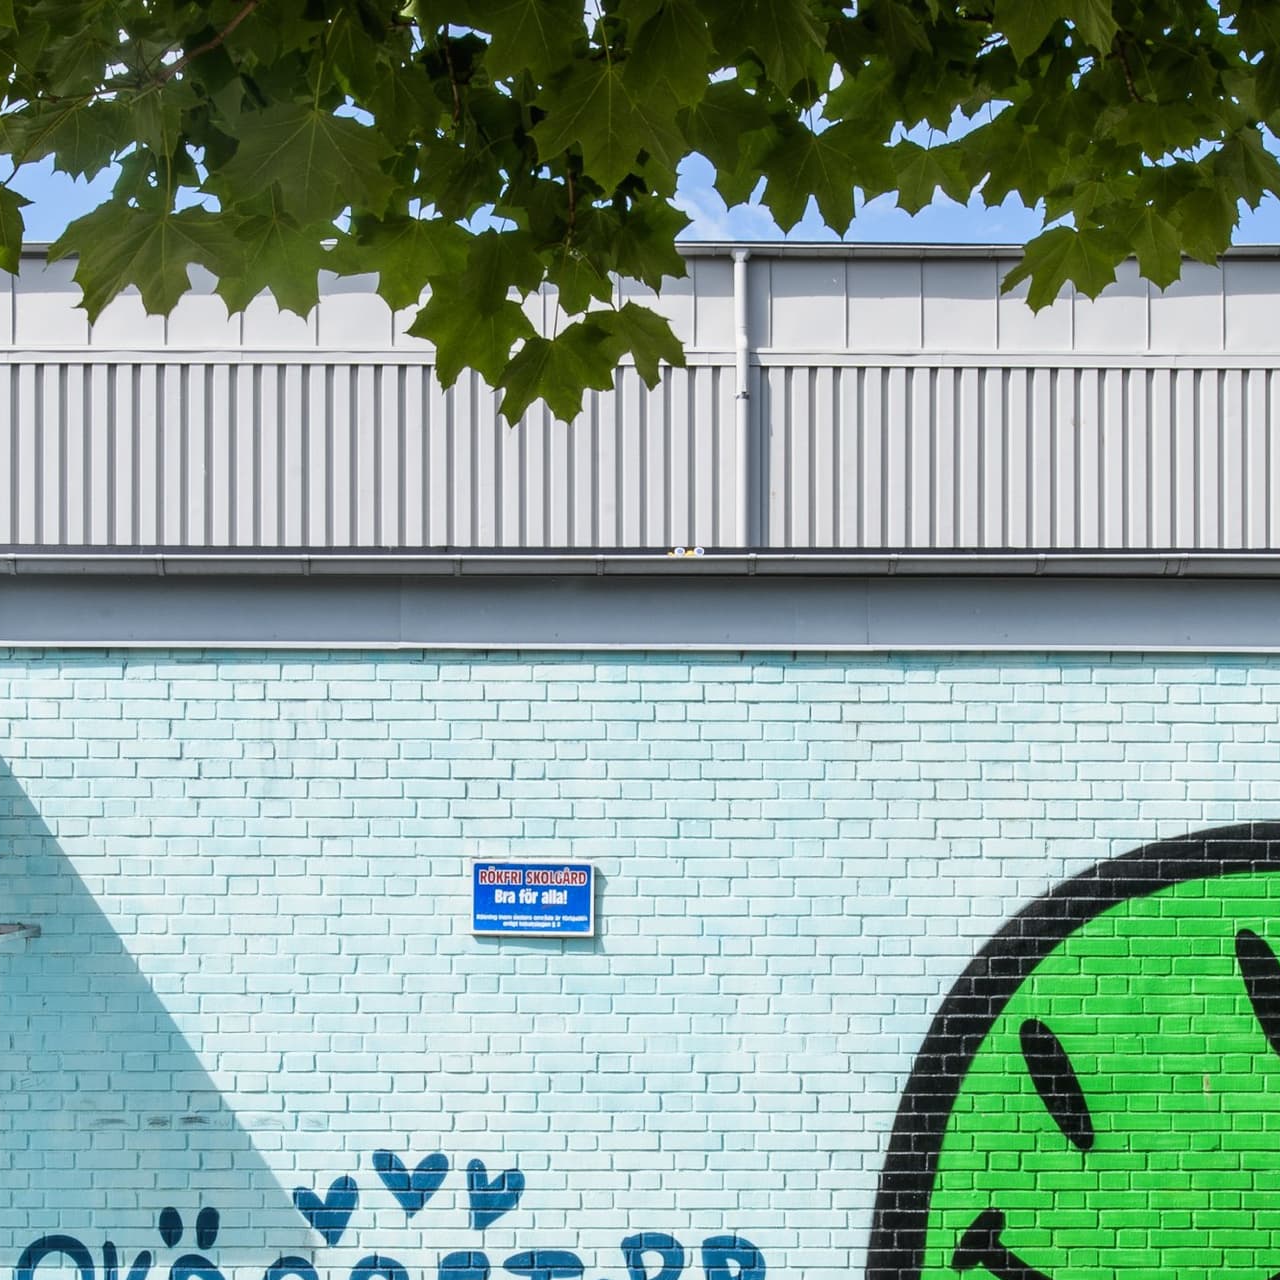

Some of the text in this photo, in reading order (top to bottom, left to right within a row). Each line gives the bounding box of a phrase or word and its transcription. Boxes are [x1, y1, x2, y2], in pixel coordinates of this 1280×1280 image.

[479, 866, 587, 886] RÖKFRI SKOLGÅRD
[494, 888, 568, 905] Bra för alla!
